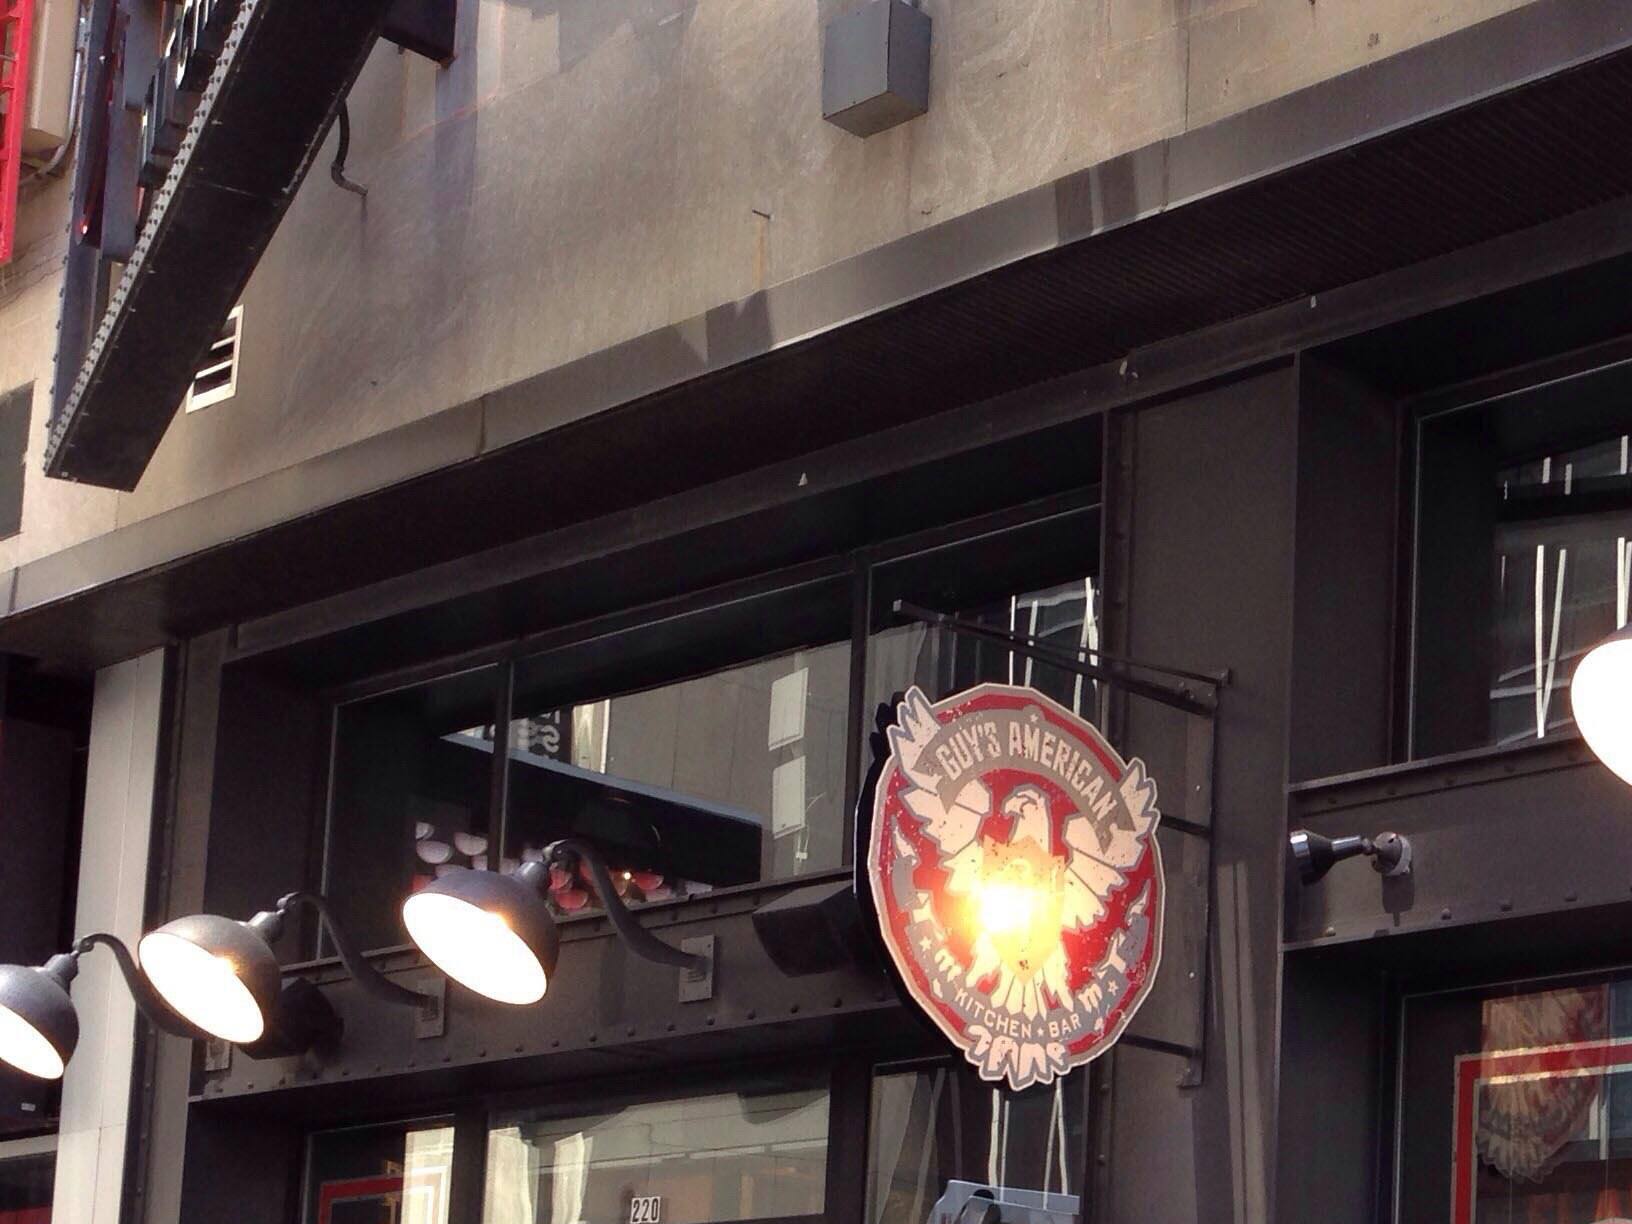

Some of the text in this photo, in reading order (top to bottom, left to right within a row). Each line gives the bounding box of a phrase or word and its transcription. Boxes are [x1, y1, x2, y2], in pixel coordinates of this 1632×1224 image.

[936, 721, 1119, 822] GUY'S AMERICAN
[954, 987, 1081, 1039] KITCHEN BAR
[632, 1197, 659, 1222] 220
